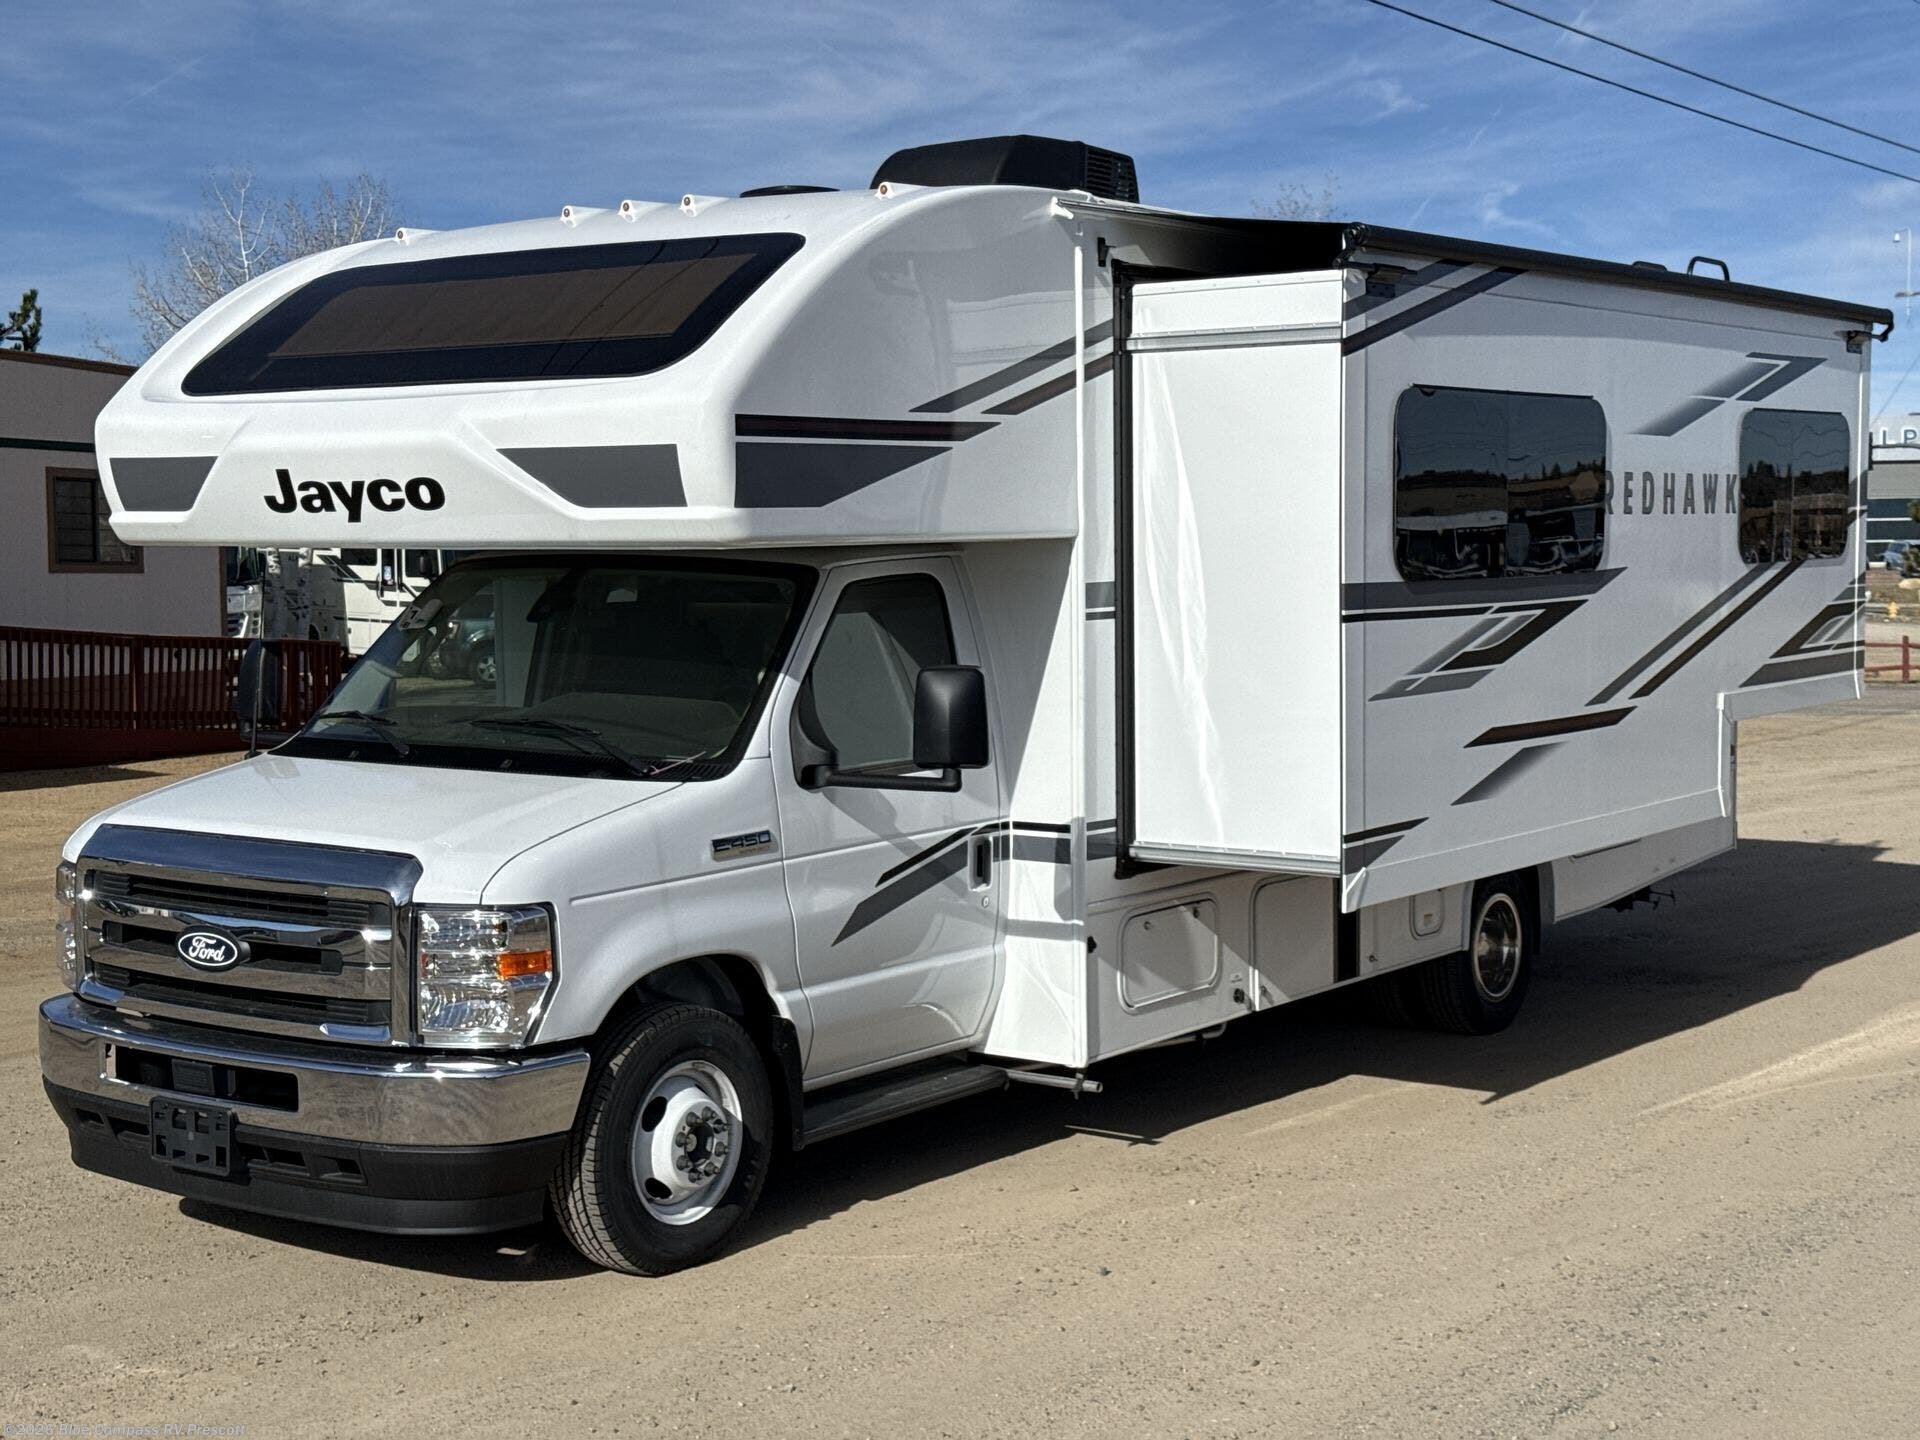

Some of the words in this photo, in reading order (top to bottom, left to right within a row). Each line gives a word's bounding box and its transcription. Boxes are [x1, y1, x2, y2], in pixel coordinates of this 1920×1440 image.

[263, 468, 446, 523] Jayco
[1605, 470, 1738, 515] REDHAWK
[188, 936, 226, 962] Ford
